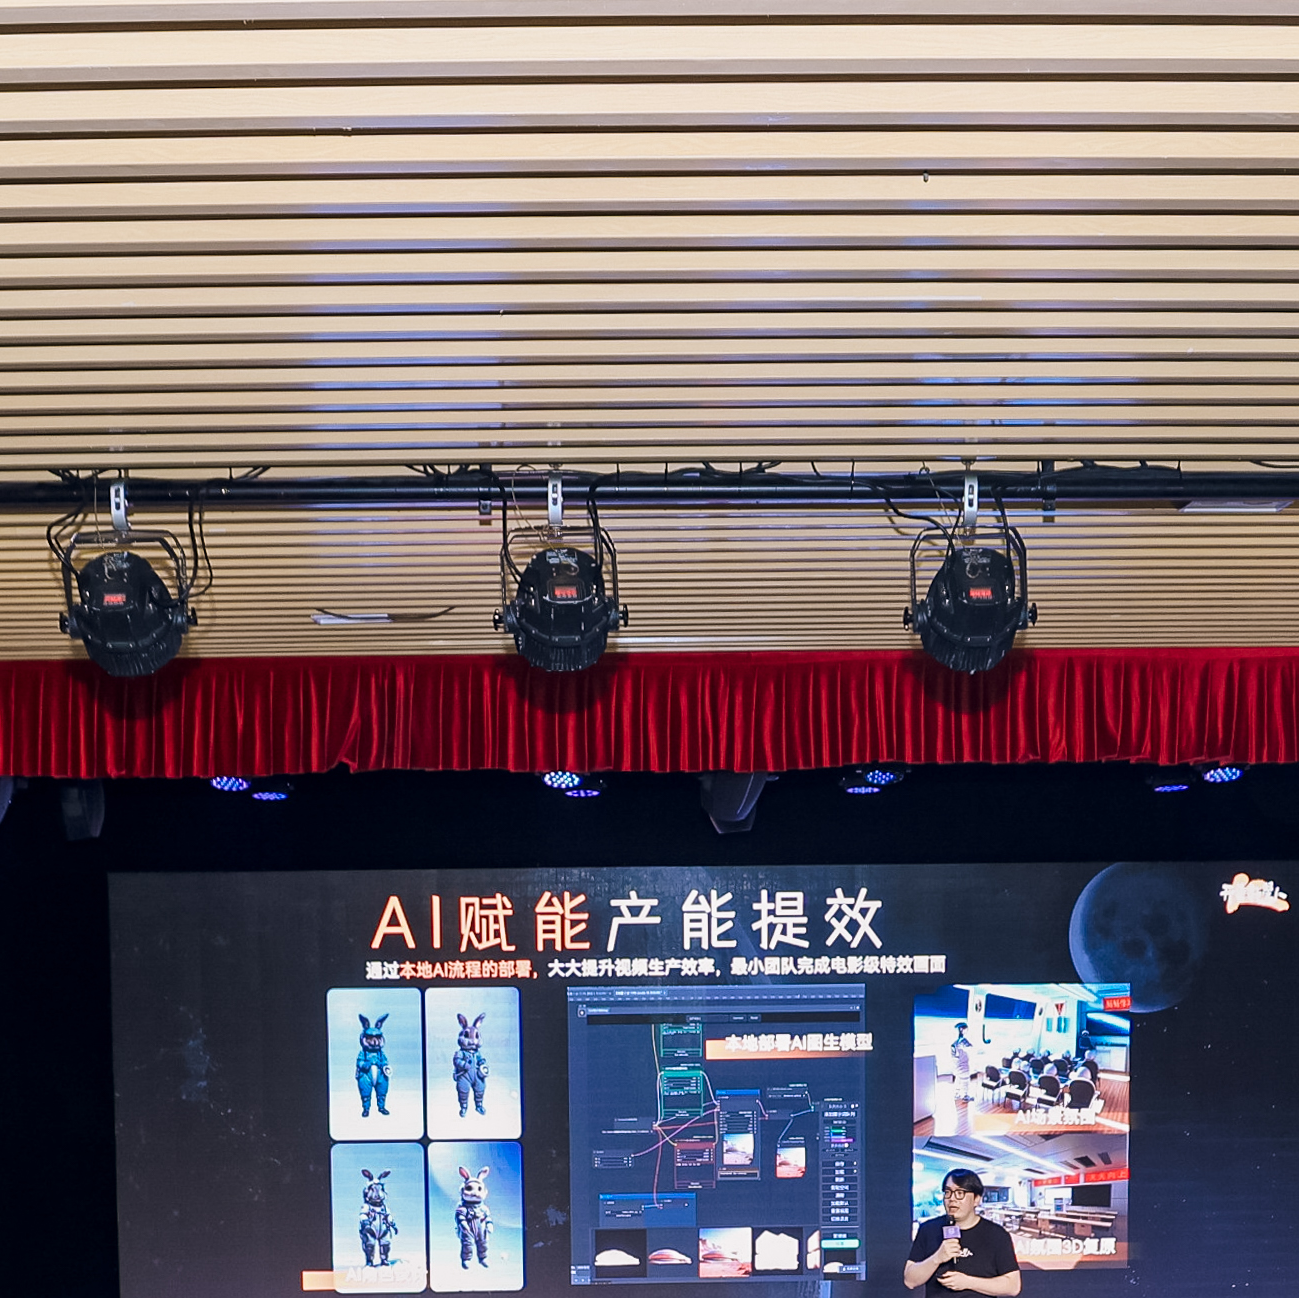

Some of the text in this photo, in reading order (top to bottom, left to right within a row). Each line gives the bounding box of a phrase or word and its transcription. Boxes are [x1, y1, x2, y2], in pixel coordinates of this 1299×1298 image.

[370, 887, 883, 953] AI赋能产能提效
[724, 1032, 874, 1052] 本地部署AI图生模型
